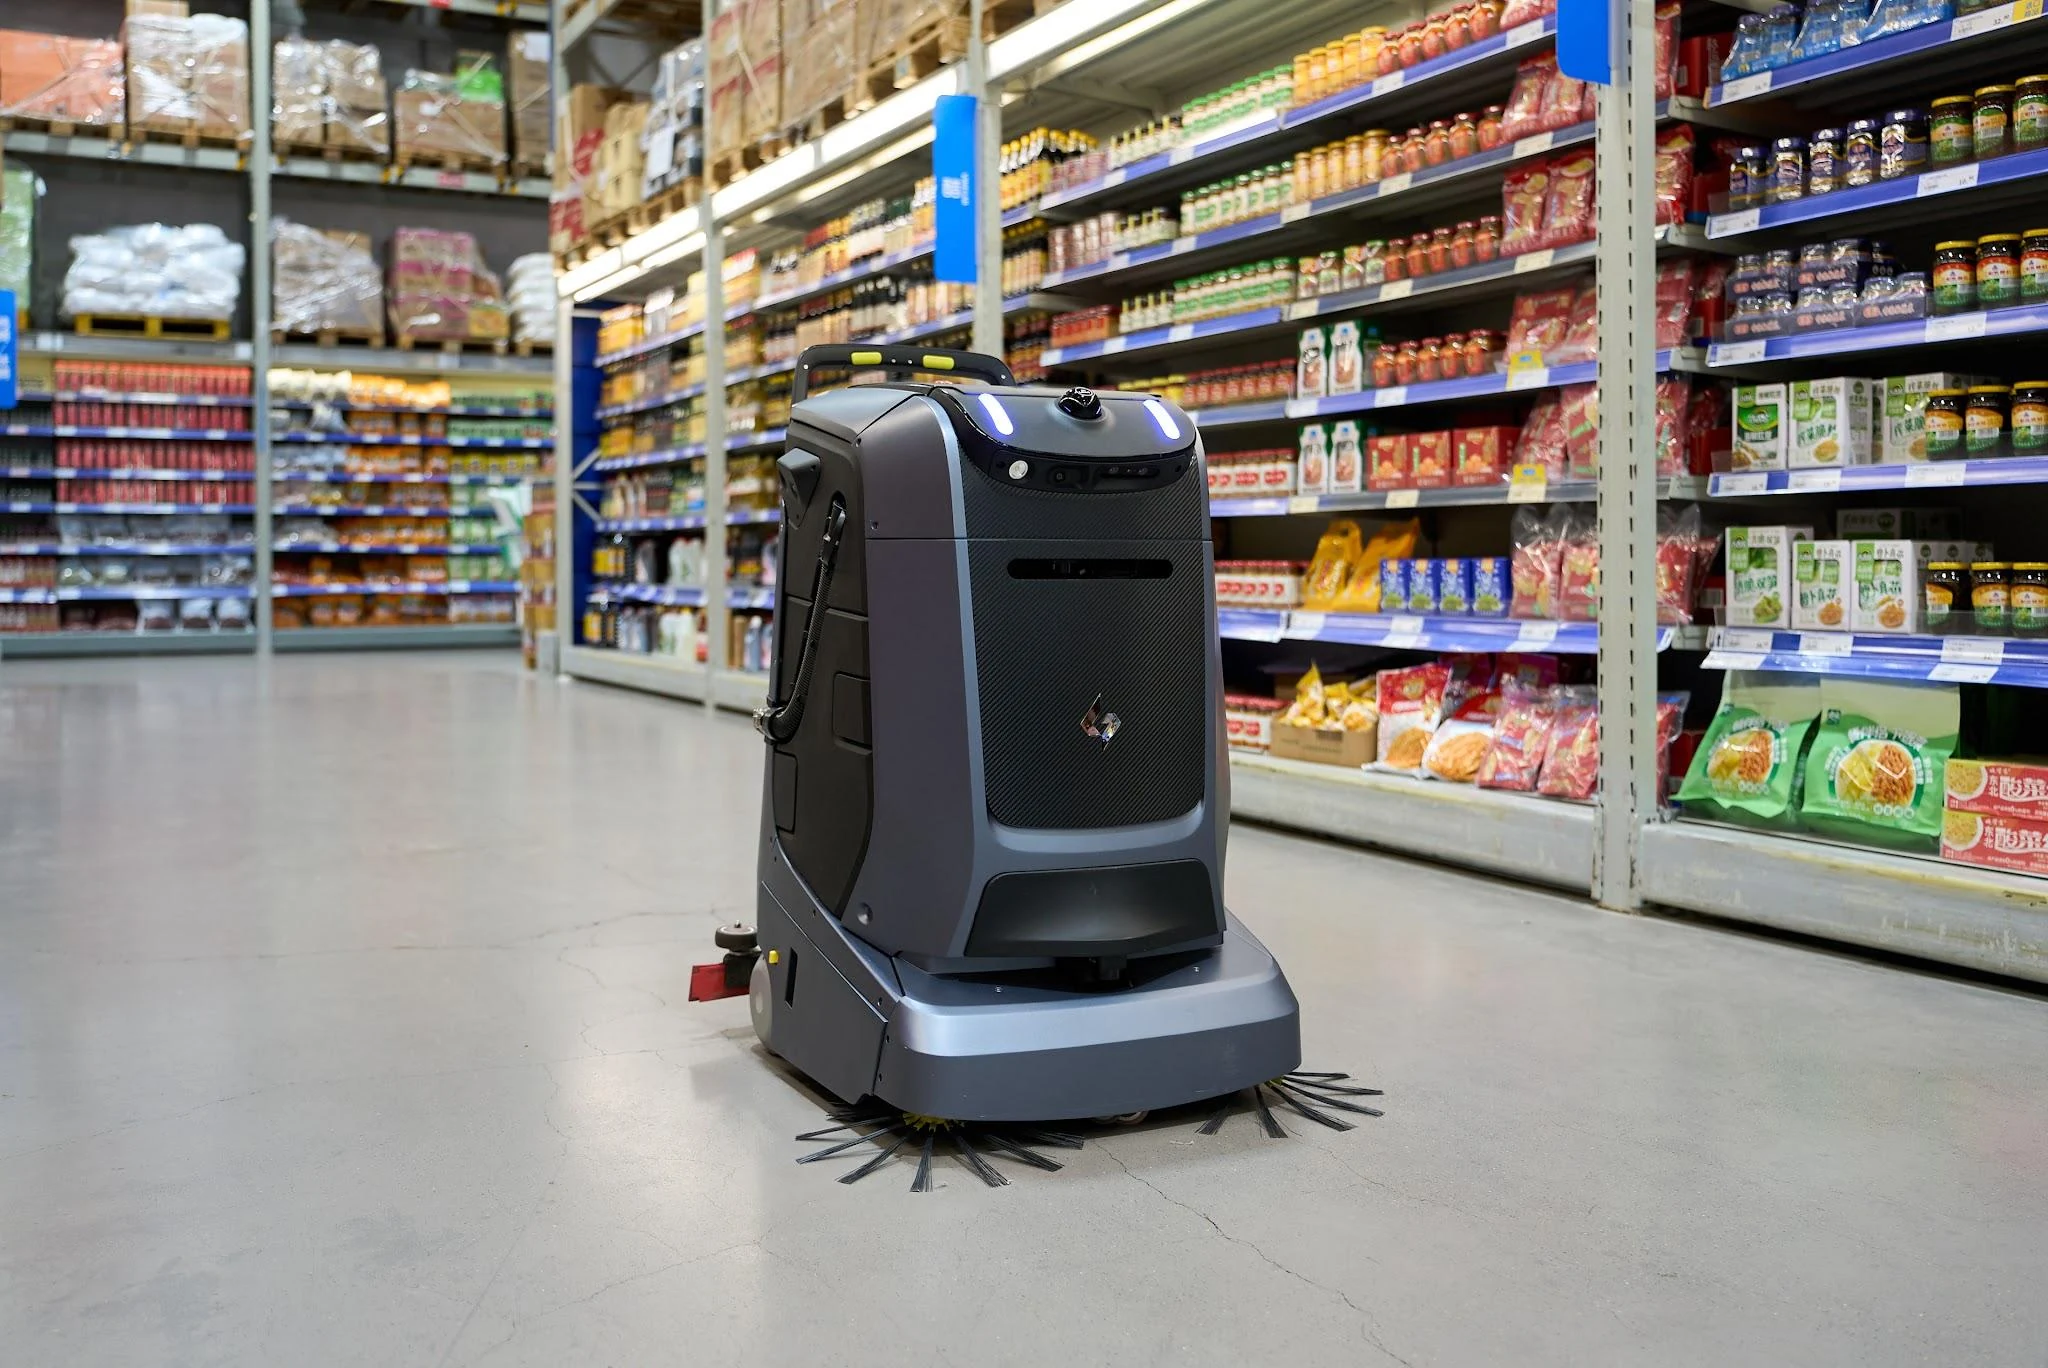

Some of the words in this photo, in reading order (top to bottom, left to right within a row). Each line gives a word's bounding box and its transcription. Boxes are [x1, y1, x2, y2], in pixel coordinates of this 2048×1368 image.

[1989, 774, 1999, 797] 东北
[2000, 776, 2048, 801] 酸菜
[1984, 826, 1994, 849] 东北
